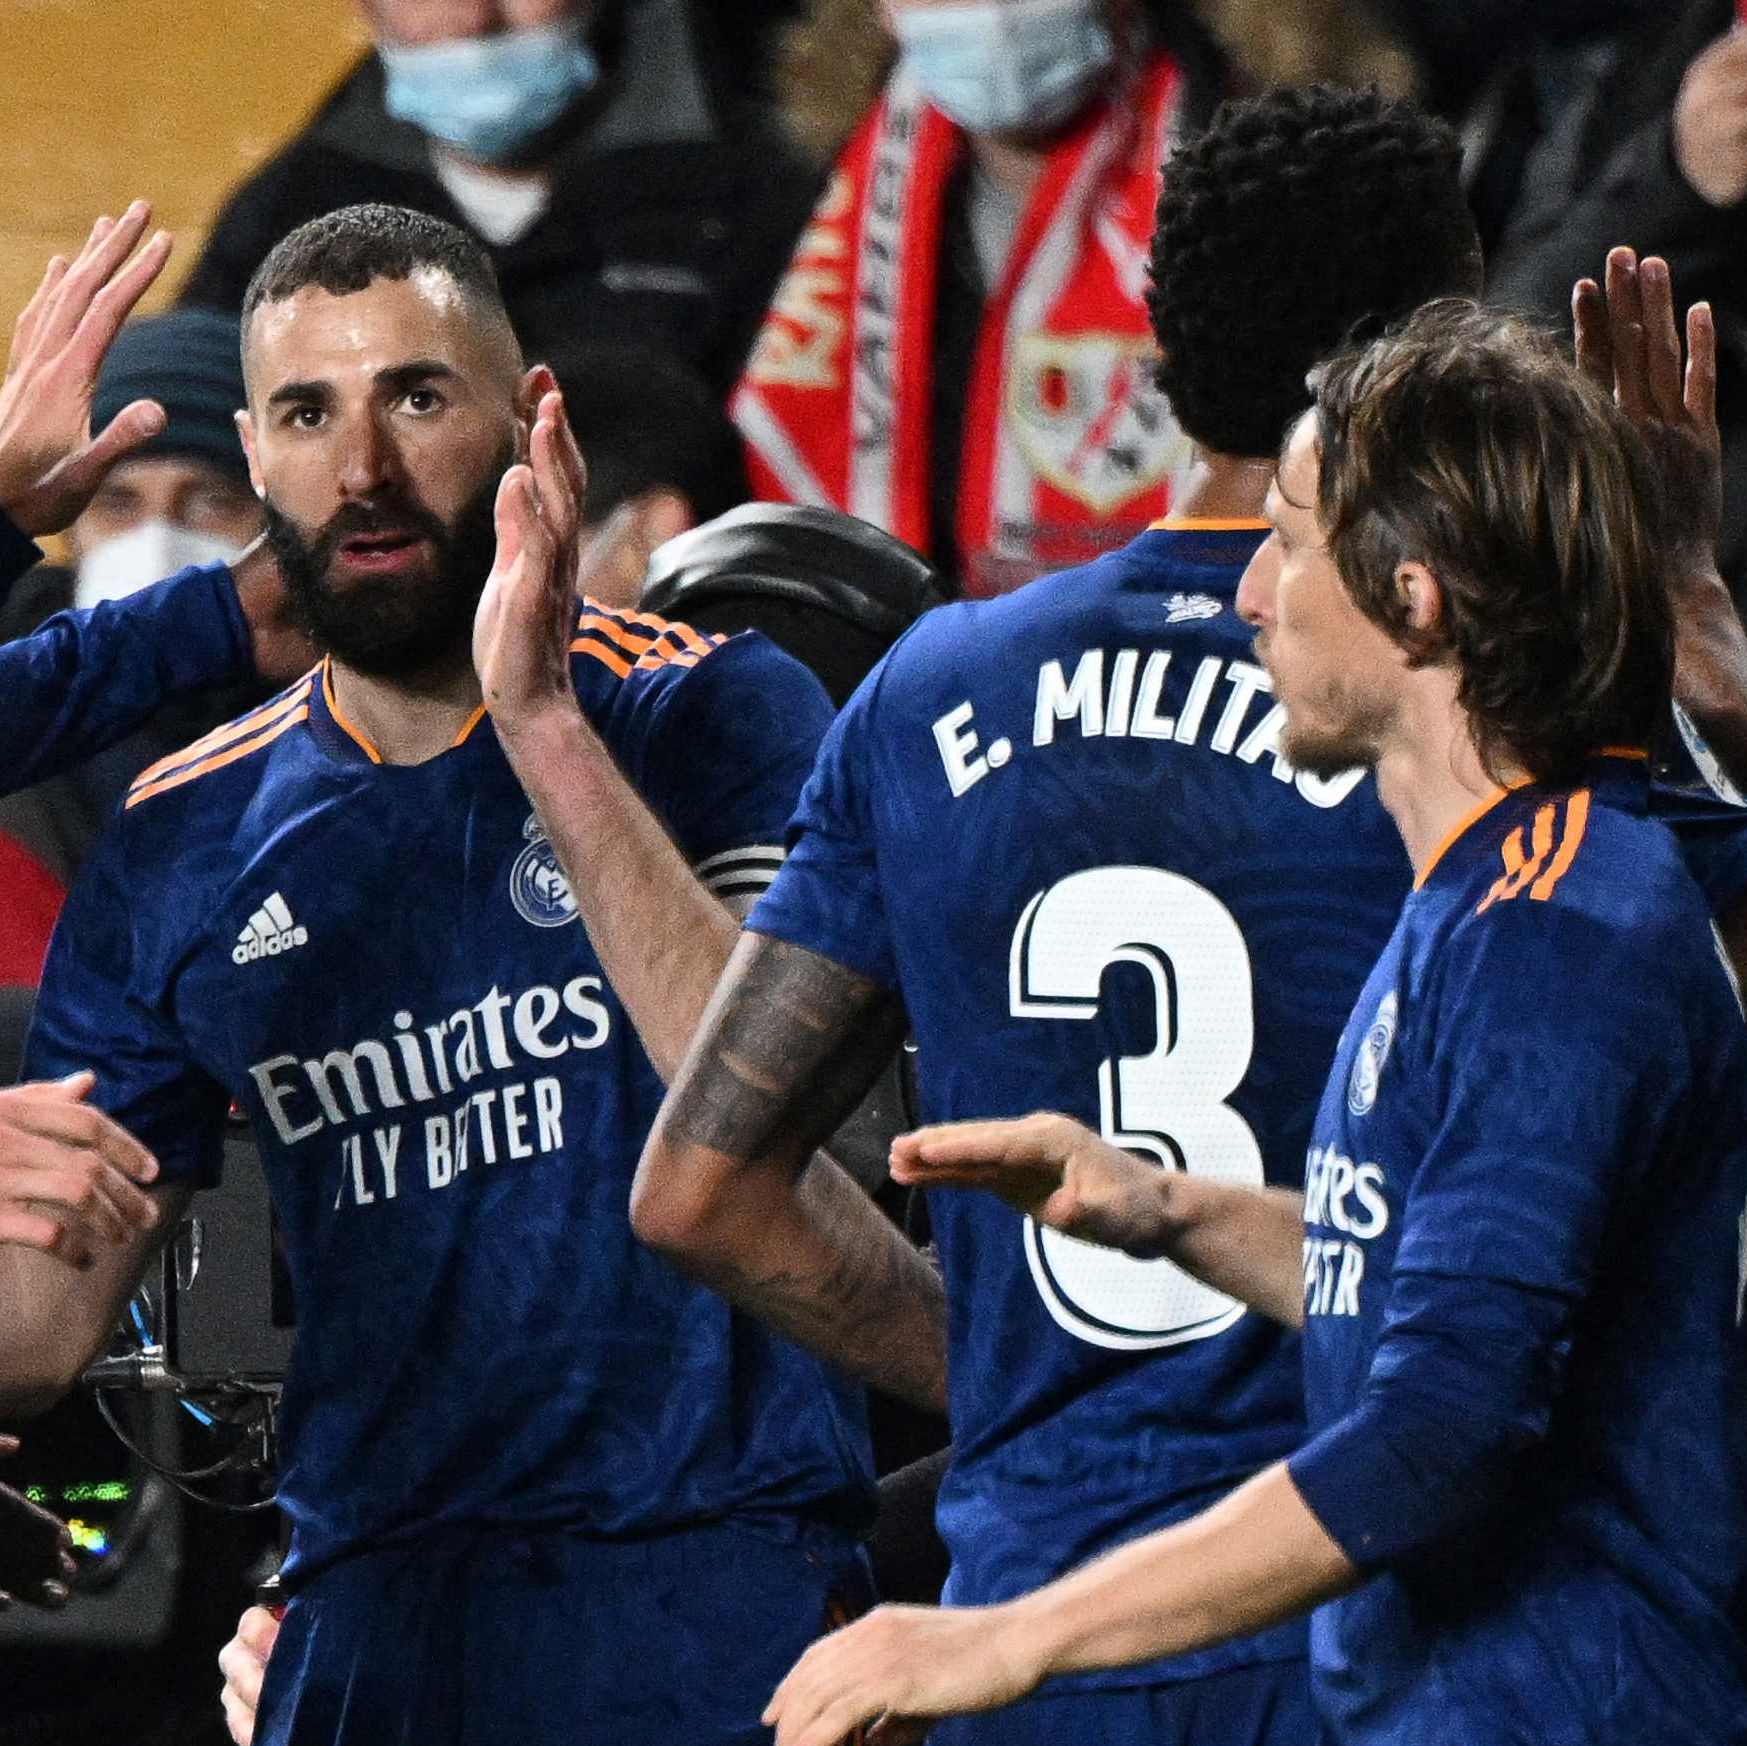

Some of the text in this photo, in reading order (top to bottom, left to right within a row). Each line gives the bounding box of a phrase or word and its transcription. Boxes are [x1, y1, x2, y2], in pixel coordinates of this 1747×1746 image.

[932, 648, 1370, 808] E. MILITA
[247, 974, 611, 1147] Emirates
[1009, 864, 1266, 1352] 3
[334, 1123, 401, 1211] LY
